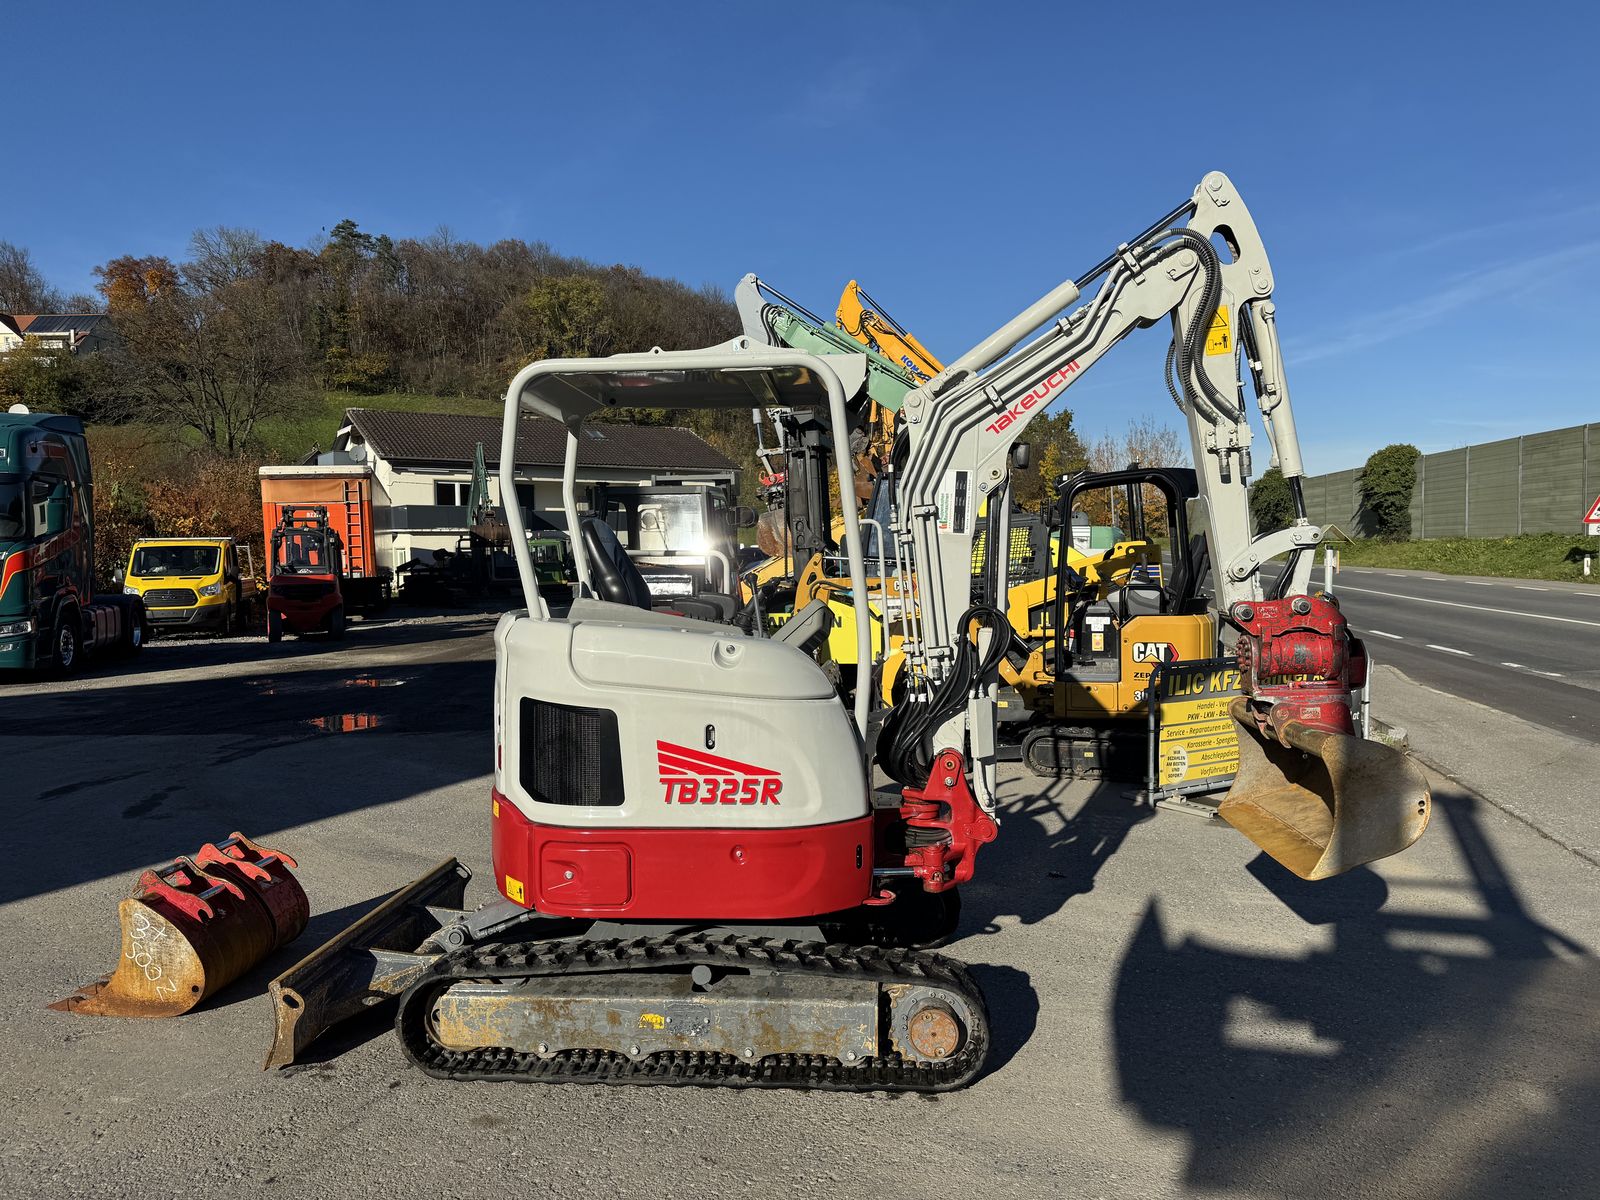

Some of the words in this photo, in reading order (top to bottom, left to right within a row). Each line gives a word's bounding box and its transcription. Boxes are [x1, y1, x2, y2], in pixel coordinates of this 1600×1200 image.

[1133, 643, 1168, 663] CAT
[1168, 672, 1205, 697] ILIC
[1203, 711, 1216, 719] LKW
[1166, 728, 1185, 738] Service
[1189, 724, 1221, 736] Reparaturen
[659, 777, 783, 805] TB325R
